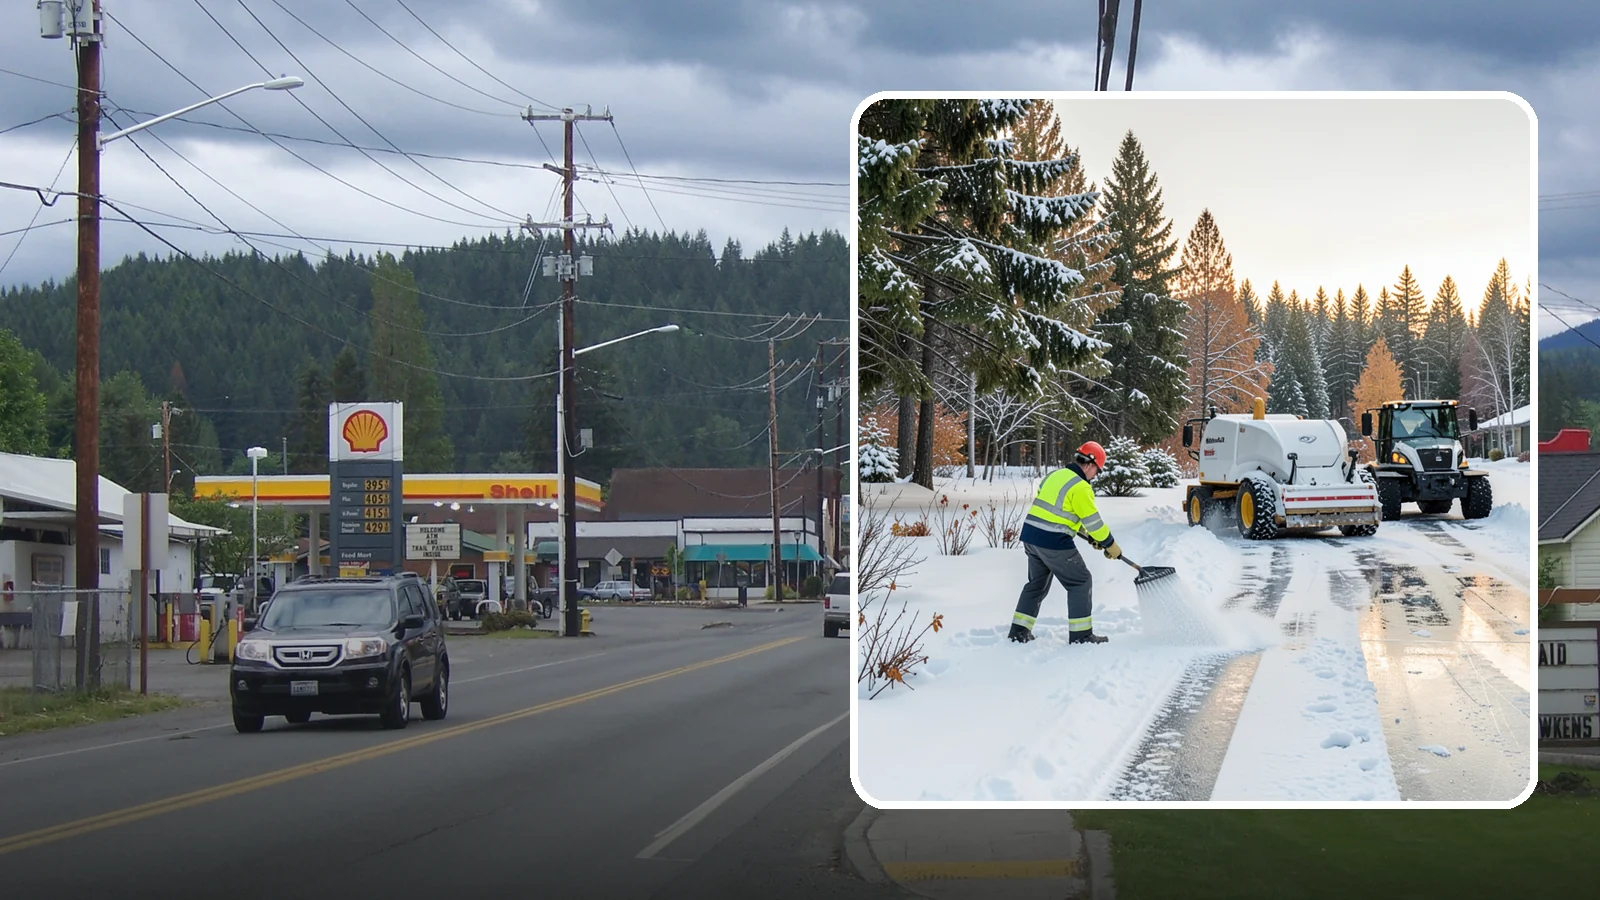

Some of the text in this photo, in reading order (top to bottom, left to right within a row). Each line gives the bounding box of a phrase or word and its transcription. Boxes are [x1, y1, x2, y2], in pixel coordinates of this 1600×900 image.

[366, 480, 383, 490] 395
[490, 484, 547, 499] Shell
[366, 494, 383, 504] 405
[366, 508, 383, 518] 415
[366, 522, 383, 532] 429
